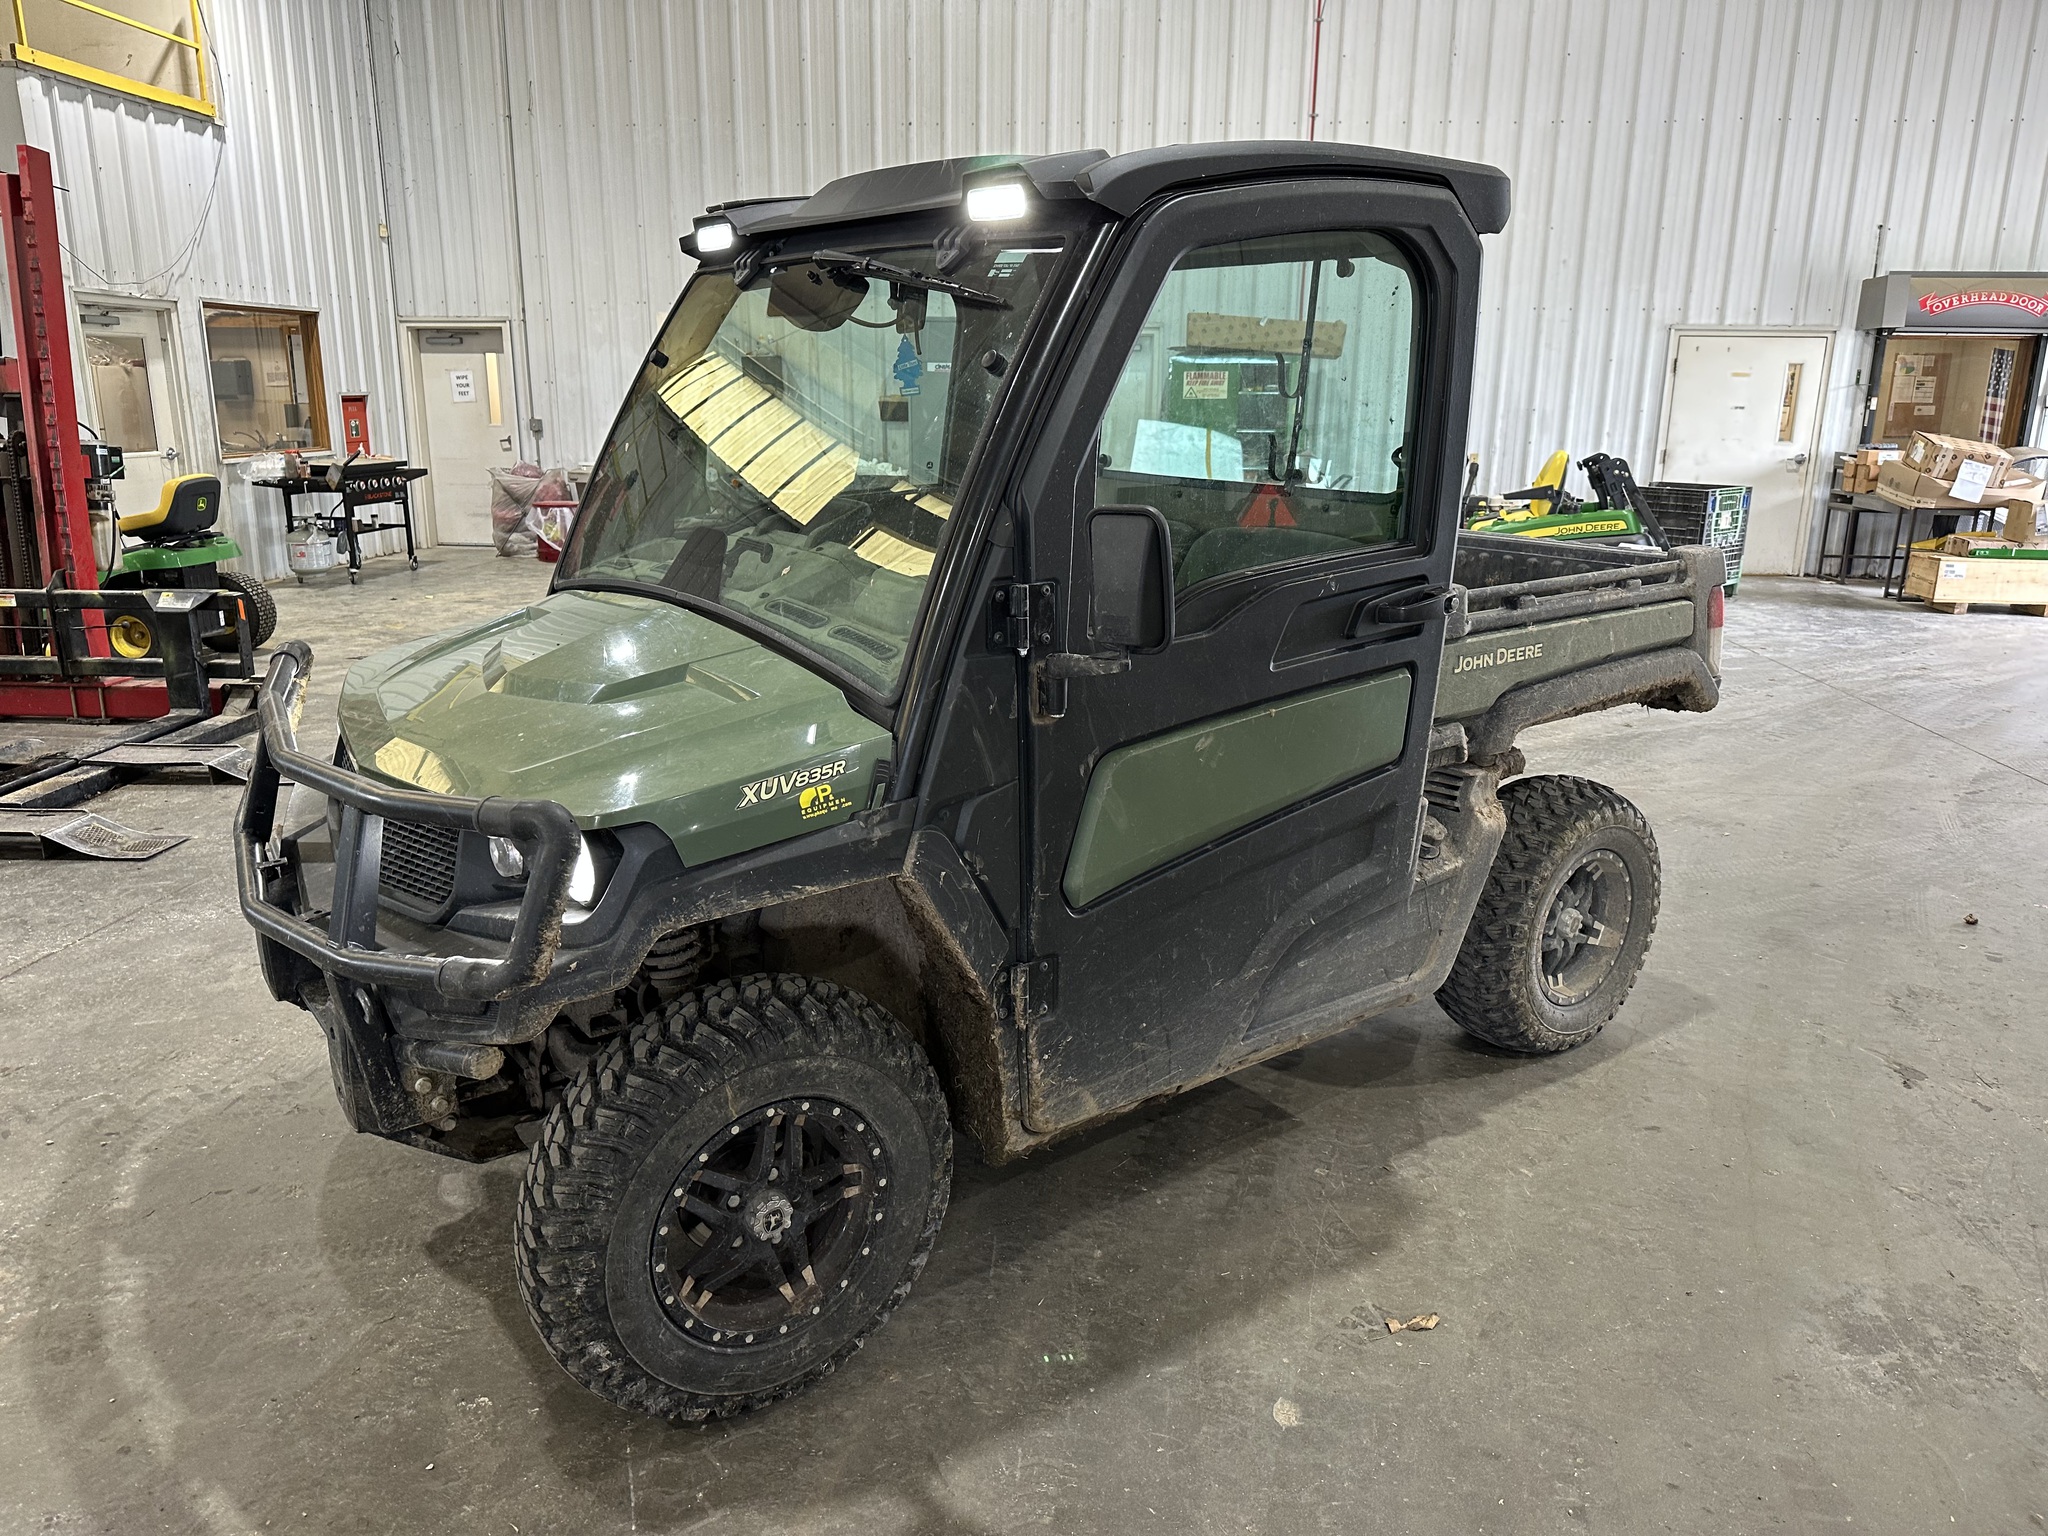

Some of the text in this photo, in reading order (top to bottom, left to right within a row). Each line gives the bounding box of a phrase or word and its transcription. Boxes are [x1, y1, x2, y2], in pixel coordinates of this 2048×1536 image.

[1932, 291, 2044, 314] OVERHEAD DOOR
[1185, 372, 1227, 380] FLAMMABLE
[1555, 522, 1620, 537] JOHN DEERE
[1453, 643, 1543, 674] JOHN DEERE
[735, 759, 847, 811] XUV835R
